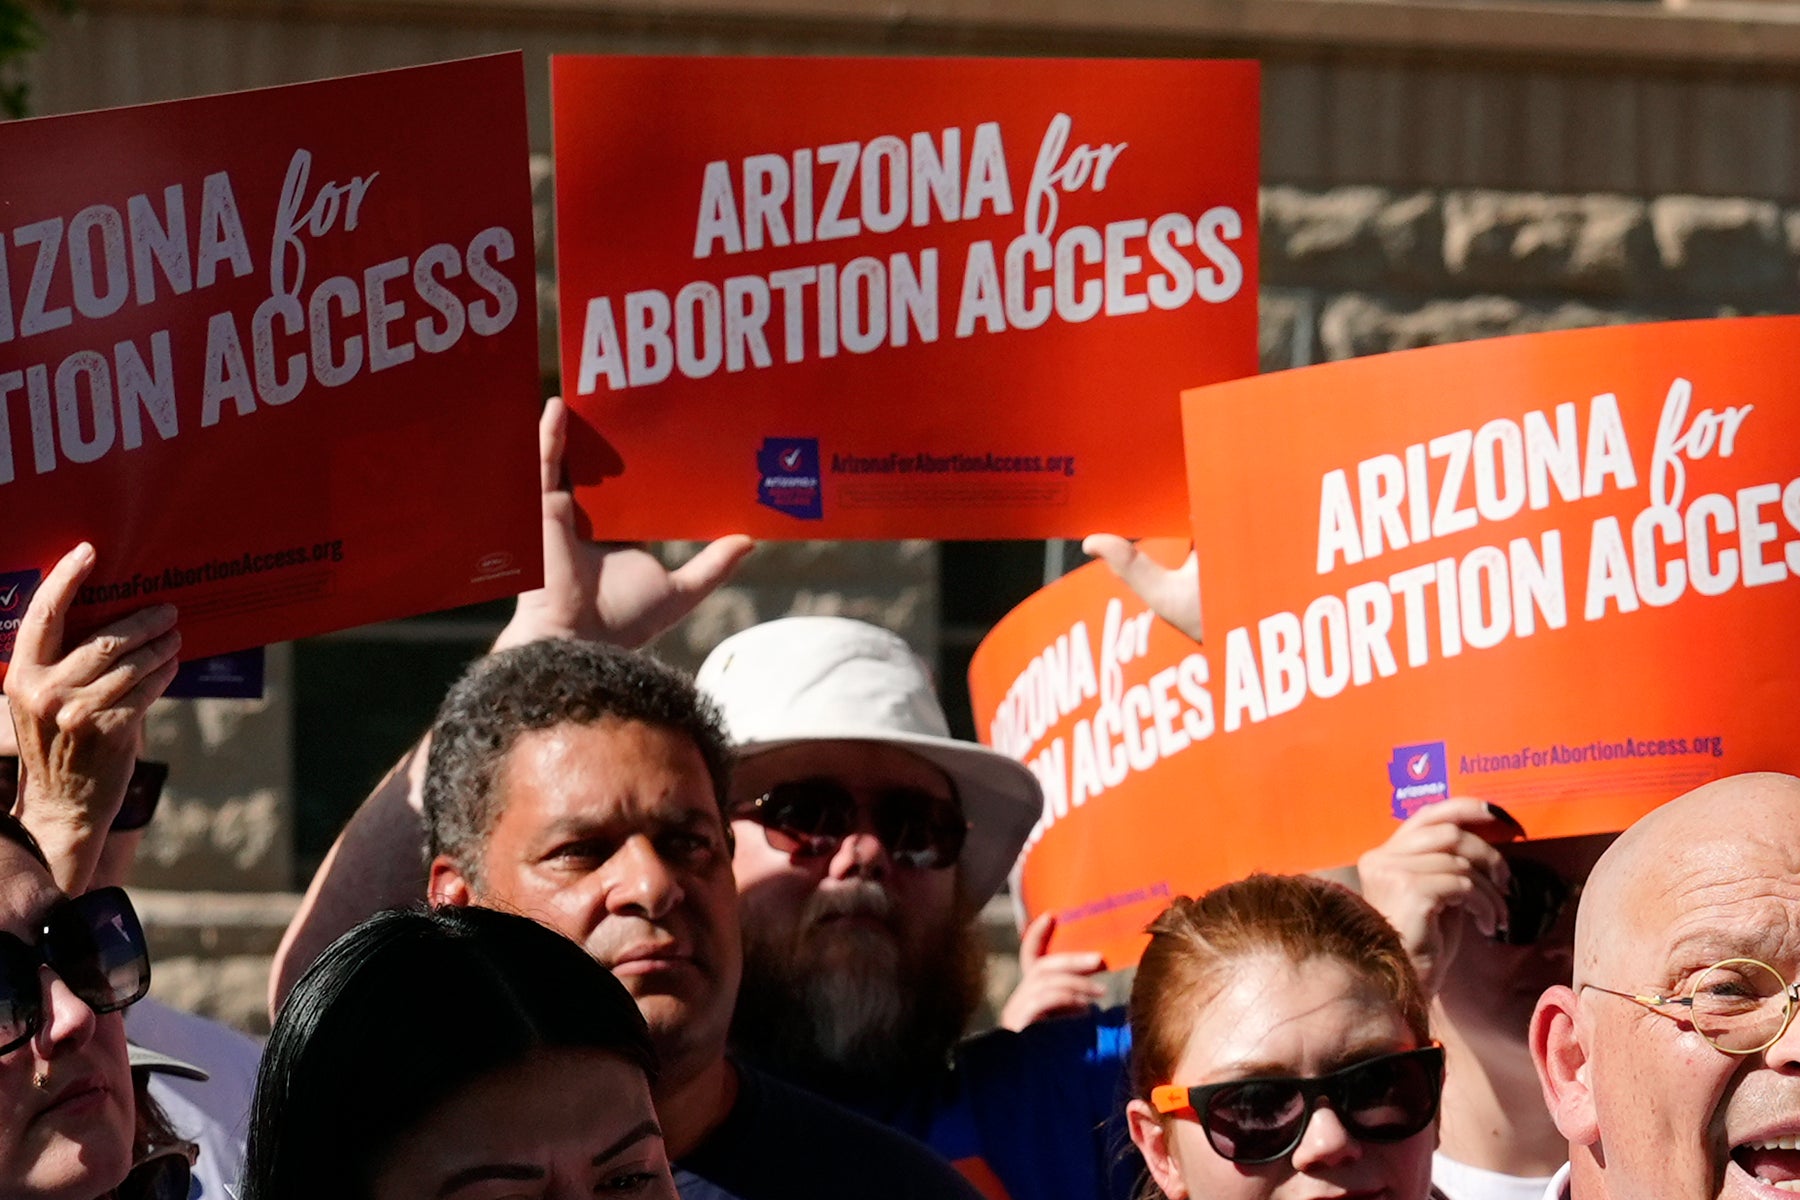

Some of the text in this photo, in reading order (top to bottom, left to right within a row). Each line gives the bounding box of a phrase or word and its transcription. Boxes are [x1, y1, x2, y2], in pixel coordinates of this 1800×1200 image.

[271, 147, 380, 304] for
[693, 112, 1129, 259] ARIZONA for
[201, 226, 518, 428] ACCESS
[577, 206, 1243, 396] ABORTION ACCESS
[830, 453, 1075, 477] ArizonaForAbortionAccess.org
[1316, 376, 1754, 574] ARIZONA for
[1101, 596, 1155, 706] for
[1223, 527, 1567, 733] ABORTION
[1459, 735, 1724, 776] ArizonaForAbortionAccess.org
